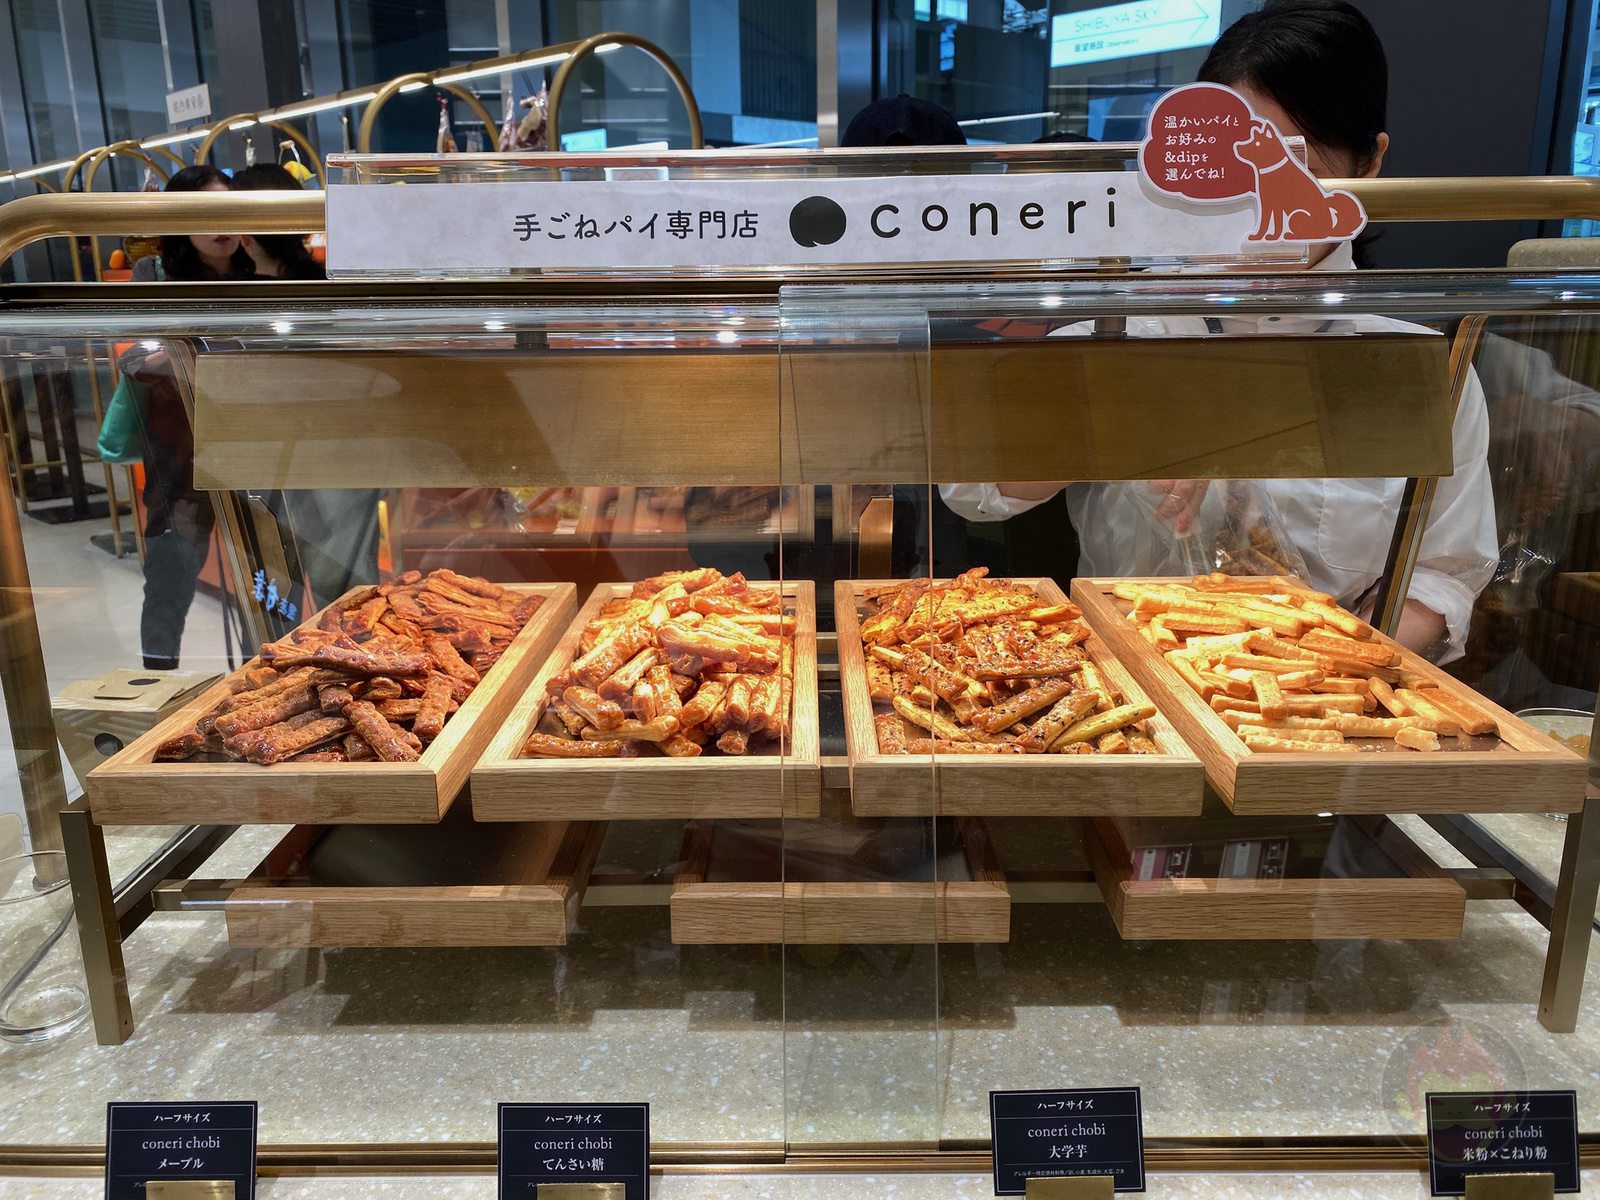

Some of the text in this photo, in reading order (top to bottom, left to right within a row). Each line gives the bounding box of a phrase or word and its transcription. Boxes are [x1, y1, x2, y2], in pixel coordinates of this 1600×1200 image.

[1164, 114, 1240, 129] 温かいパイと
[1165, 132, 1217, 146] お好みの
[1164, 150, 1209, 166] &dipを
[513, 186, 1118, 243] 手ごねパイ専門店 coneri
[1037, 1099, 1094, 1110] ハーフサイズ
[1473, 1102, 1531, 1113] ハーフサイズ
[153, 1112, 211, 1123] ハーフサイズ
[545, 1114, 602, 1124] ハーフサイズ
[1028, 1123, 1106, 1138] coneri chobi
[1464, 1125, 1543, 1139] coneri chobi
[142, 1136, 220, 1149] coneri chobi
[534, 1137, 613, 1150] coneri chobi
[1048, 1144, 1088, 1159] 大学芋
[1463, 1146, 1548, 1161] 米粉×こねり粉
[157, 1158, 205, 1170] メープル
[543, 1157, 605, 1171] てんさい糖
